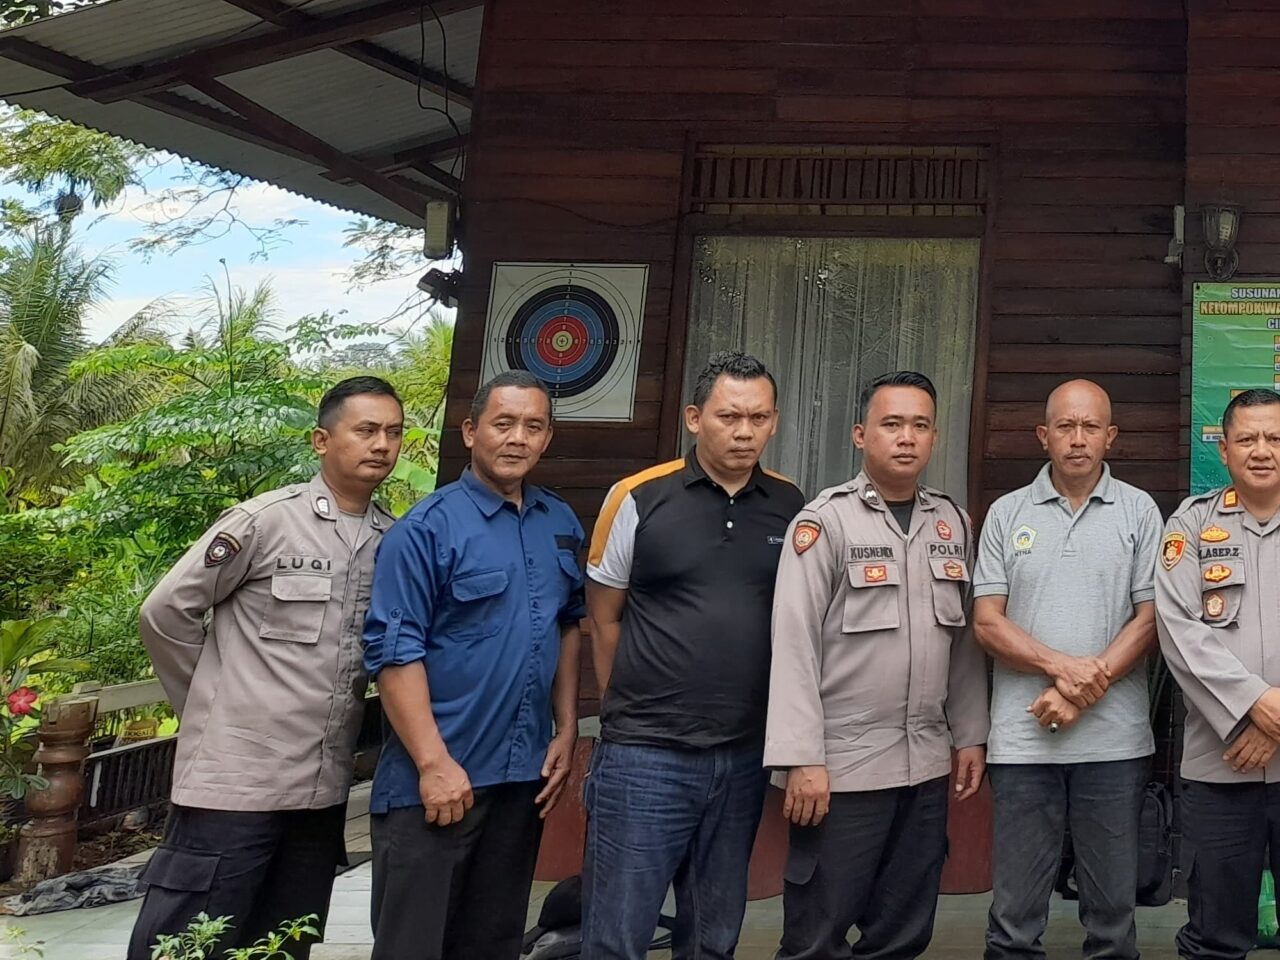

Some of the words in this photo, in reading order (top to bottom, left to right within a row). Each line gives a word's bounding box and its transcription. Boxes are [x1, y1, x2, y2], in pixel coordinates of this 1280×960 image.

[1200, 302, 1263, 315] KELOMPOK
[930, 544, 963, 556] POLRI
[276, 558, 331, 571] LUQI
